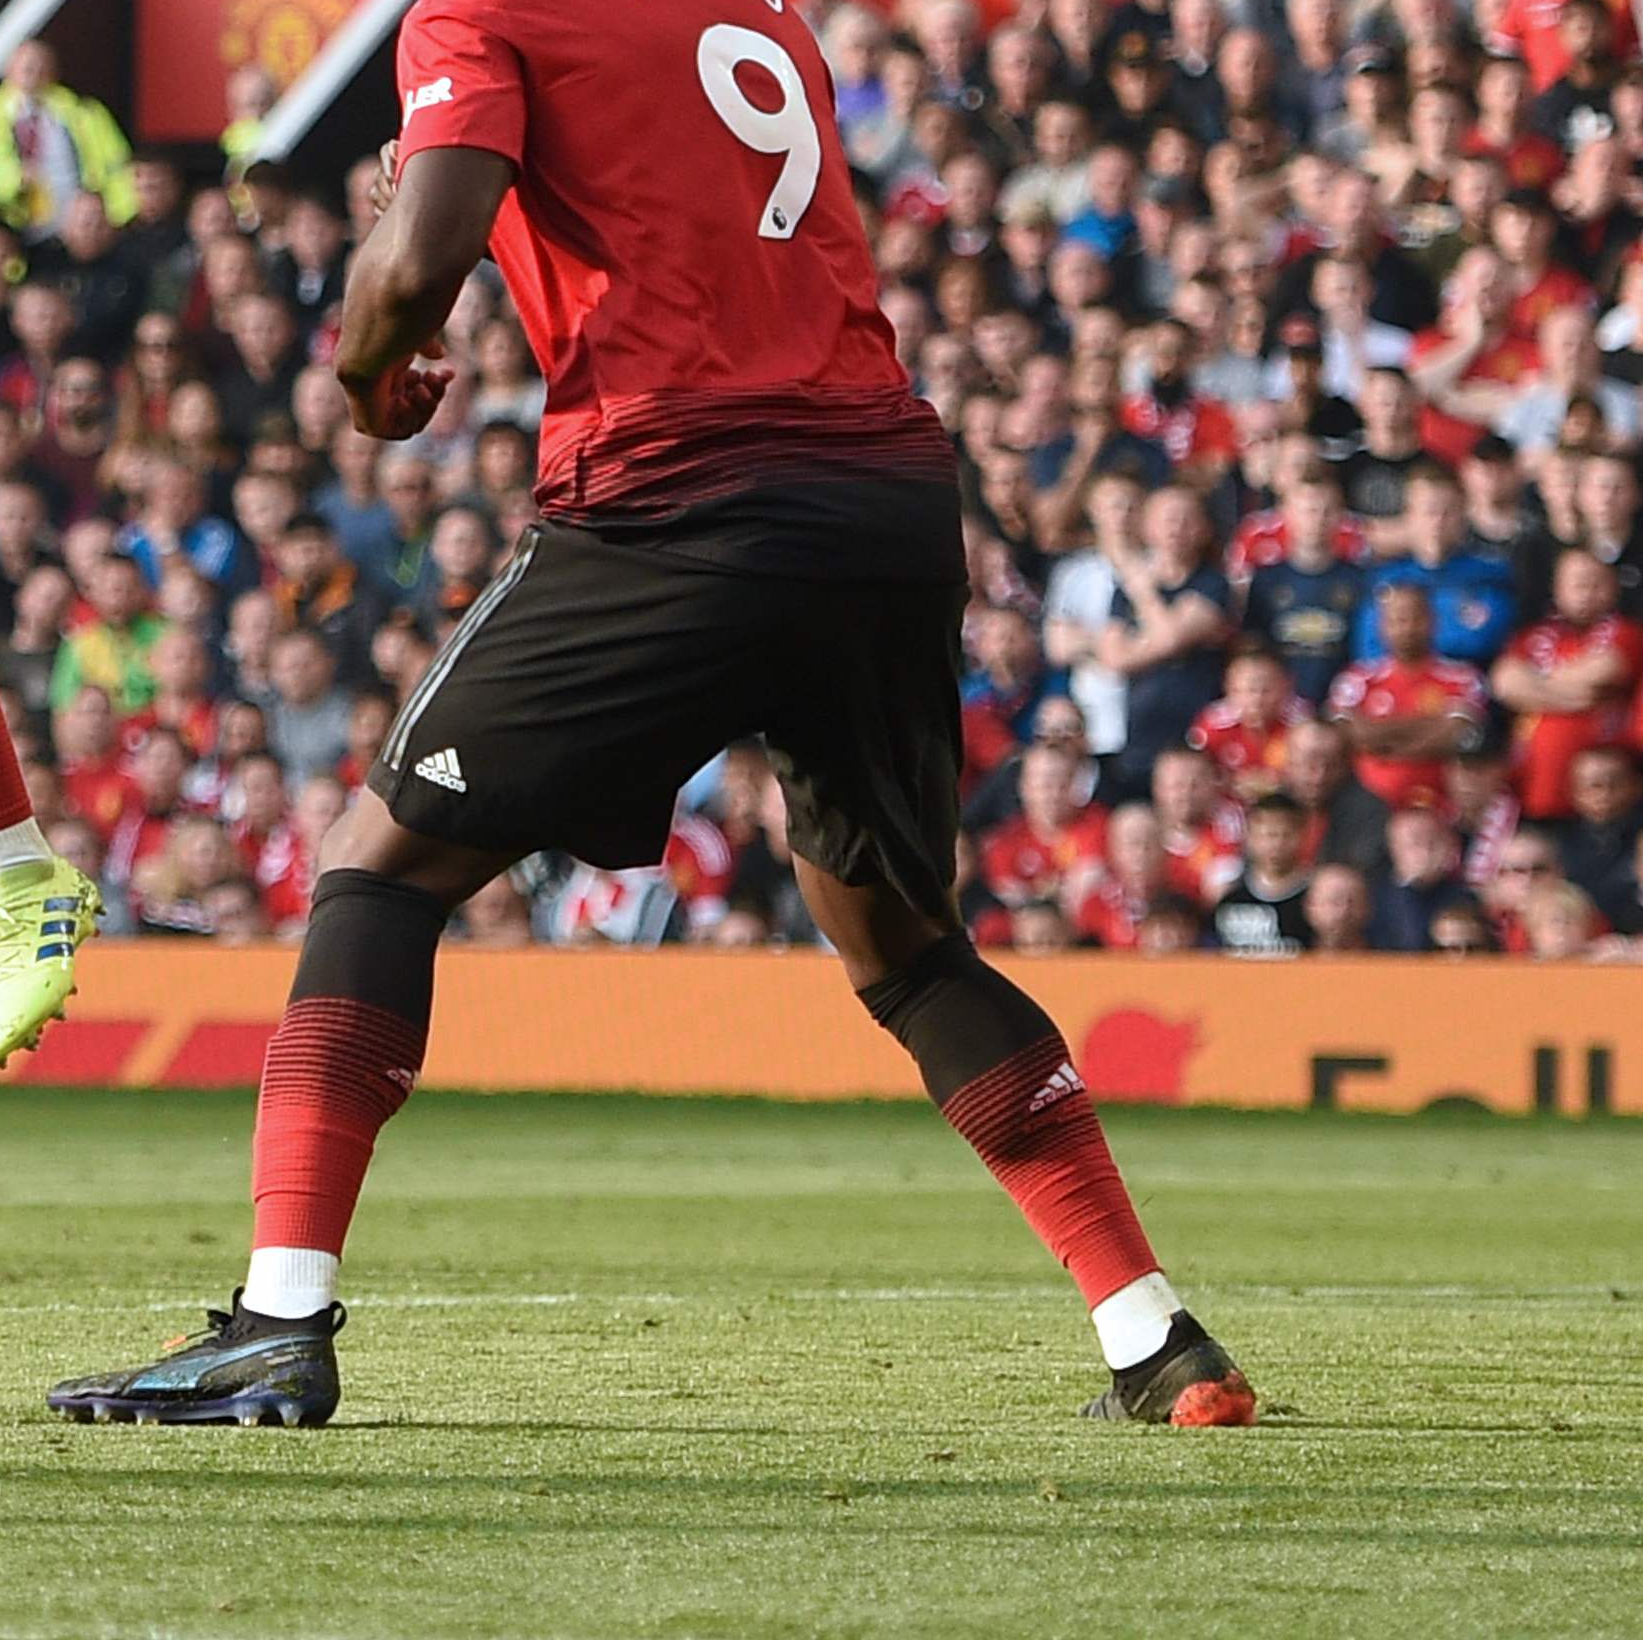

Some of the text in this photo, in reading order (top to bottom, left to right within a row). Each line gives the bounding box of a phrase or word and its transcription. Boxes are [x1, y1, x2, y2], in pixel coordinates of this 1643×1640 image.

[402, 76, 454, 129] LER
[697, 23, 821, 240] 9
[415, 762, 467, 794] adidas
